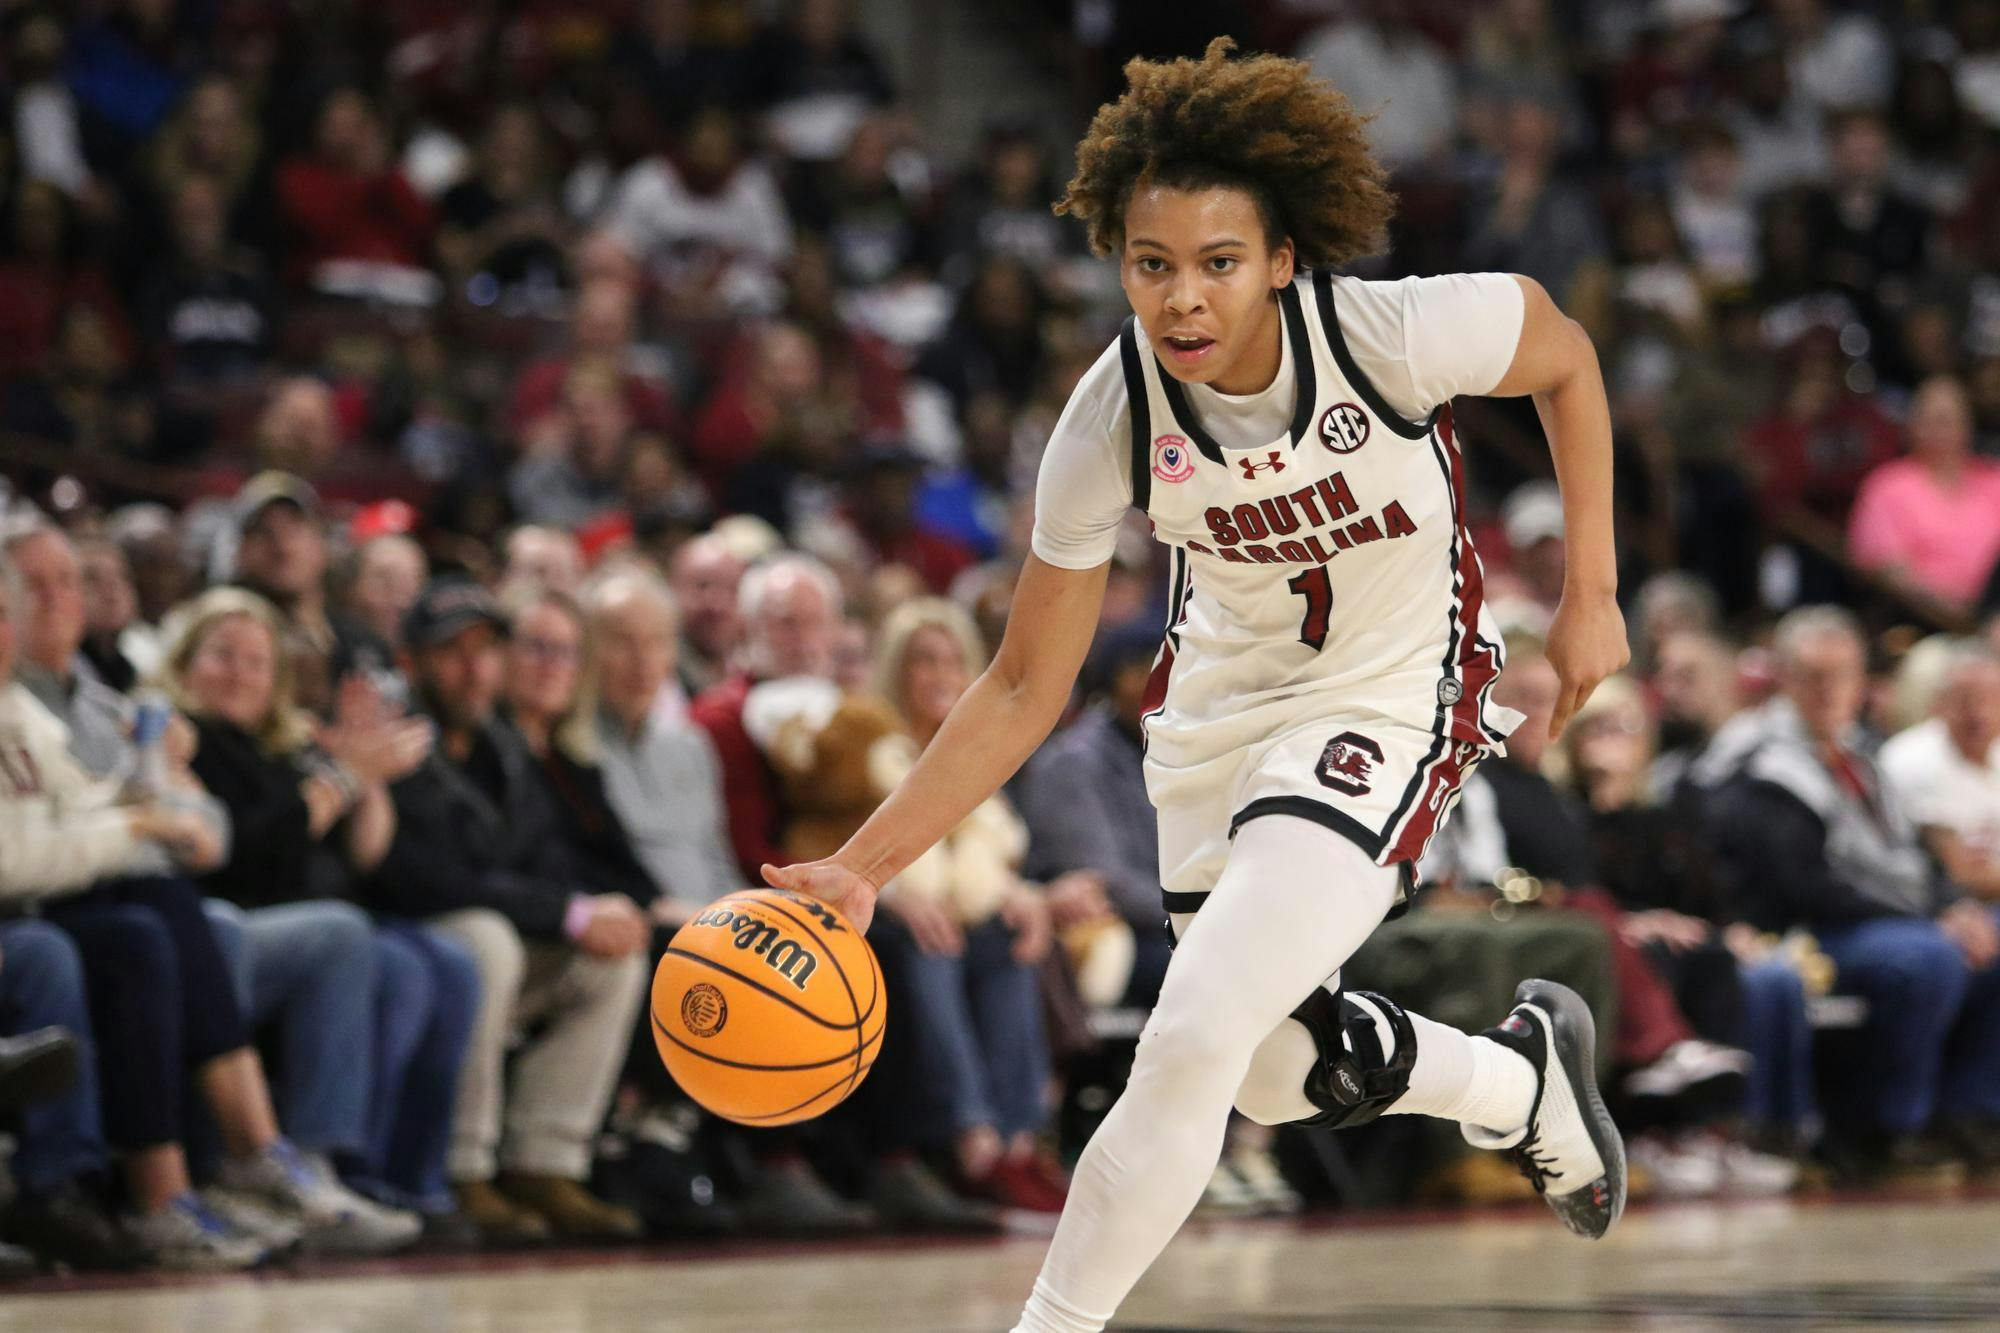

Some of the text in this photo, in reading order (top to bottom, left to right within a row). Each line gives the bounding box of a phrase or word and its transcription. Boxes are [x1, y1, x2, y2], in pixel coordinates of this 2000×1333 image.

[1321, 405, 1368, 452] SEC
[1204, 470, 1360, 547] SOUTH
[1287, 564, 1334, 653] 1
[691, 908, 819, 993] Wilson
